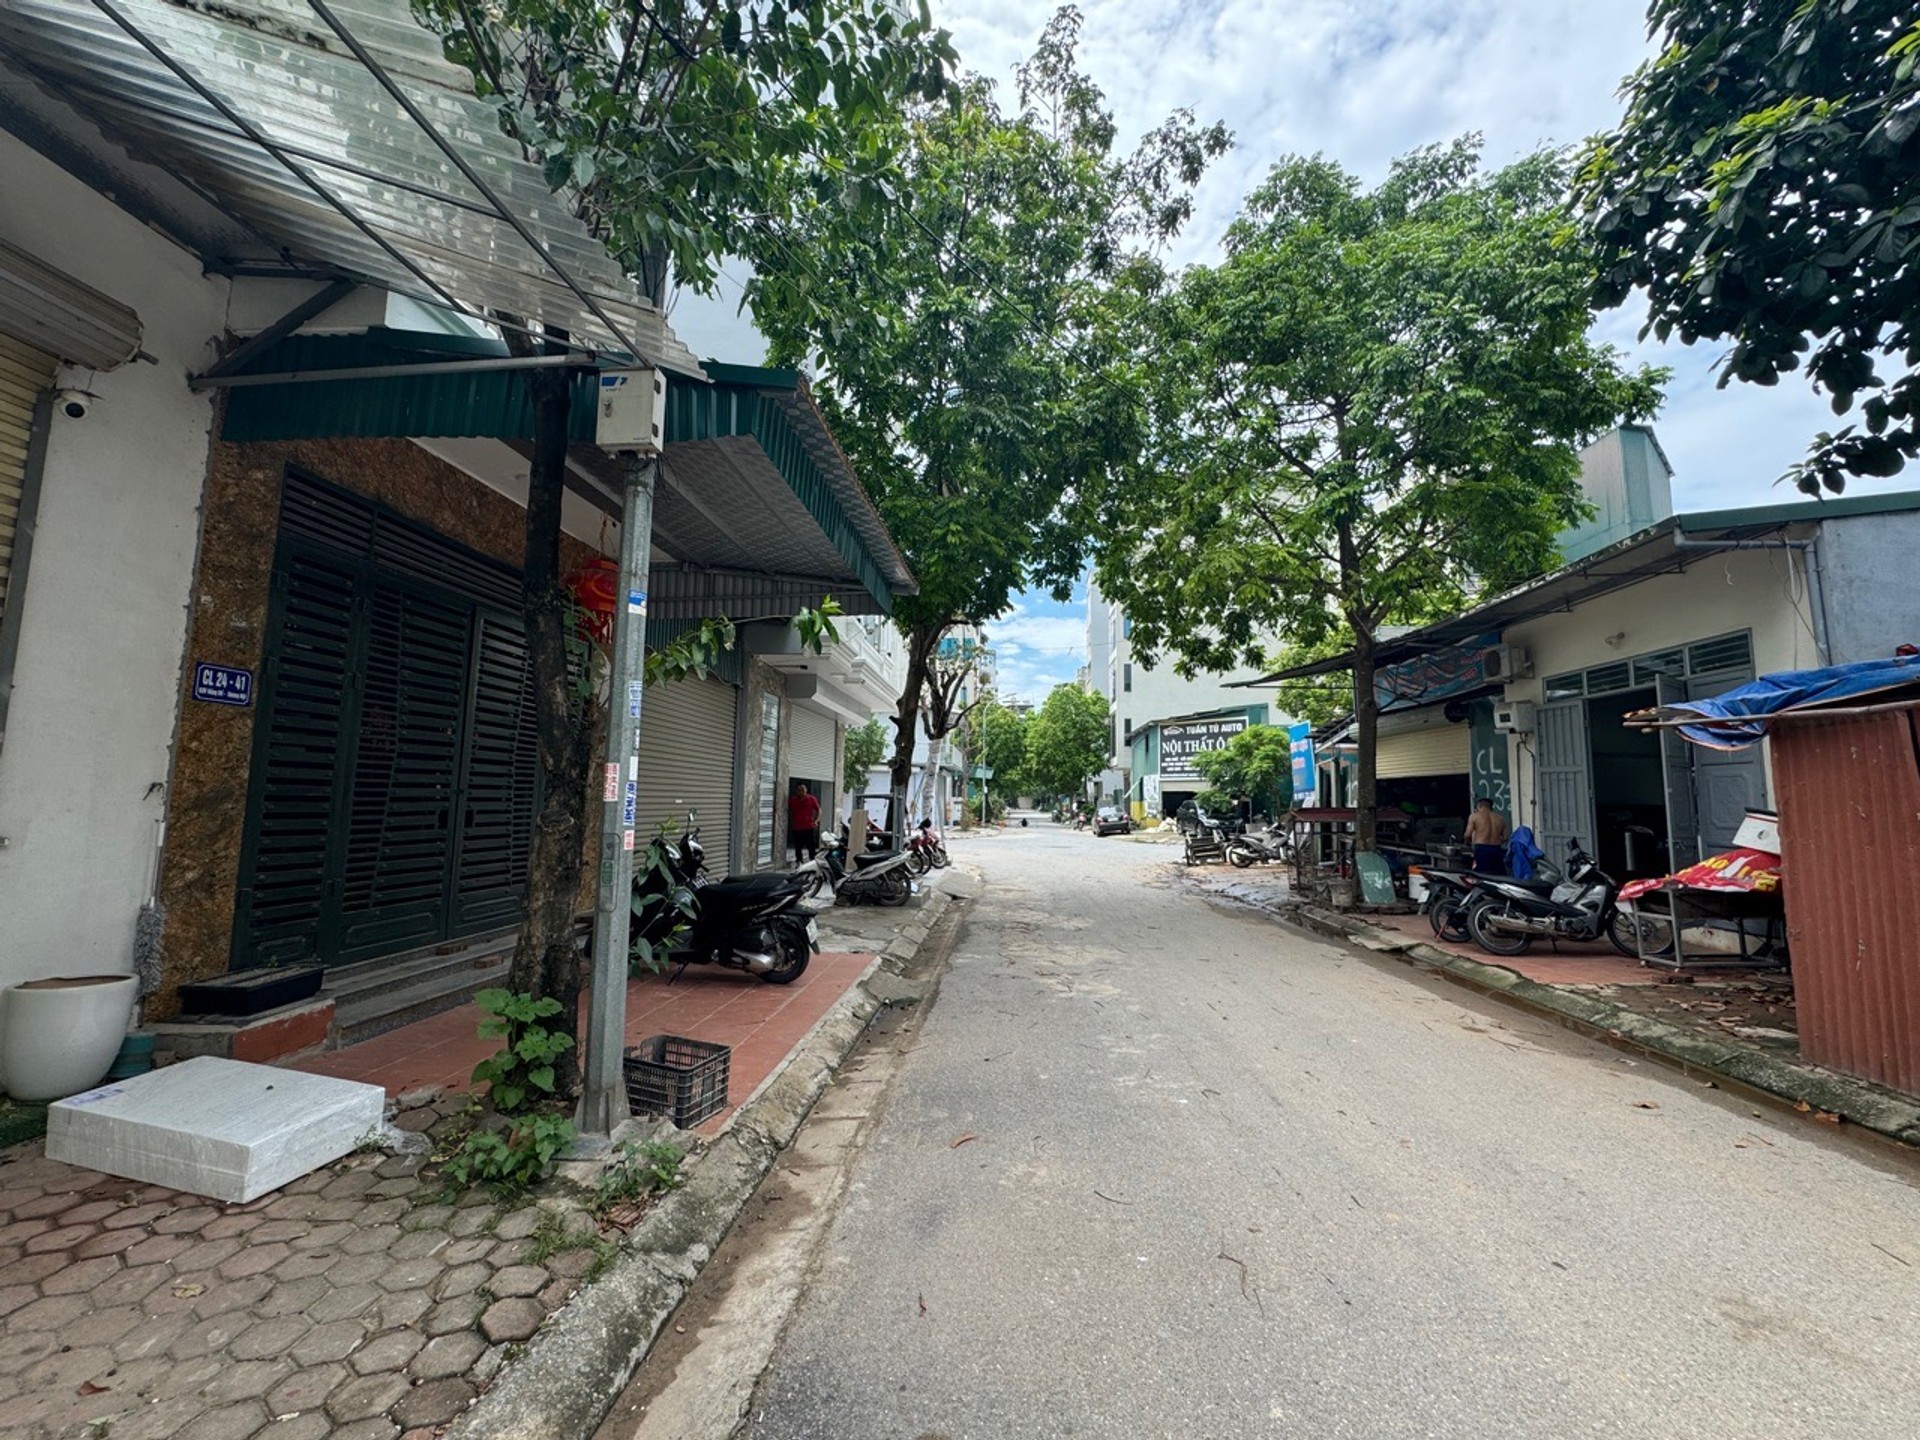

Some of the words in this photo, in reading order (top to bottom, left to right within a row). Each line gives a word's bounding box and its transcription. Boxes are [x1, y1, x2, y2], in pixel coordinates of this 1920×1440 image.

[202, 669, 214, 686] CL
[215, 671, 228, 688] 24
[235, 674, 246, 691] 41
[1221, 722, 1243, 733] AUTO
[1162, 739, 1182, 756] NỘI
[1184, 735, 1215, 753] THẤT
[1216, 736, 1226, 750] Ô
[1476, 746, 1502, 774] CL
